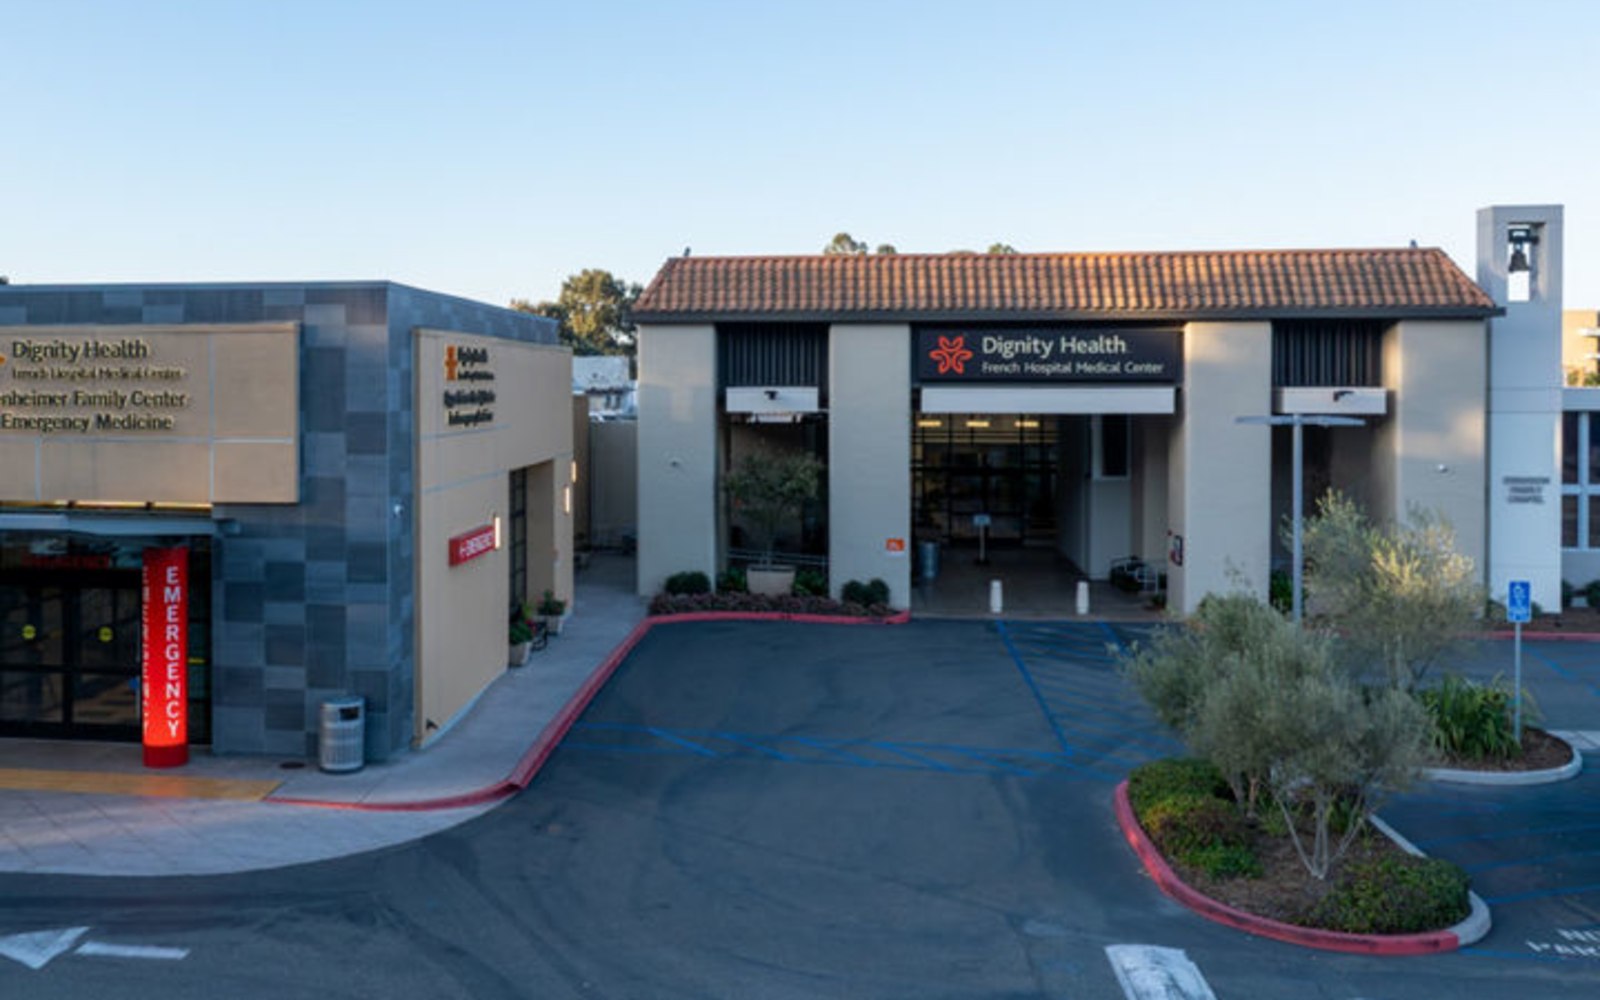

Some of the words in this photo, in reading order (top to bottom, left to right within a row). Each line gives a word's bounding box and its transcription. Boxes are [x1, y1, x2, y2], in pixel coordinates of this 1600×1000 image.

[12, 339, 81, 363] Dignity
[84, 338, 149, 359] Health
[982, 335, 1054, 359] Dignity
[1060, 334, 1127, 354] Health
[981, 361, 1020, 374] French
[1023, 361, 1072, 376] Hospital
[1075, 361, 1121, 374] Medical
[1123, 361, 1164, 374] Center
[74, 388, 127, 410] Family
[130, 390, 187, 407] Center
[1, 413, 90, 432] Emergency
[96, 412, 173, 430] Medicine
[163, 566, 182, 738] EMERGENCY
